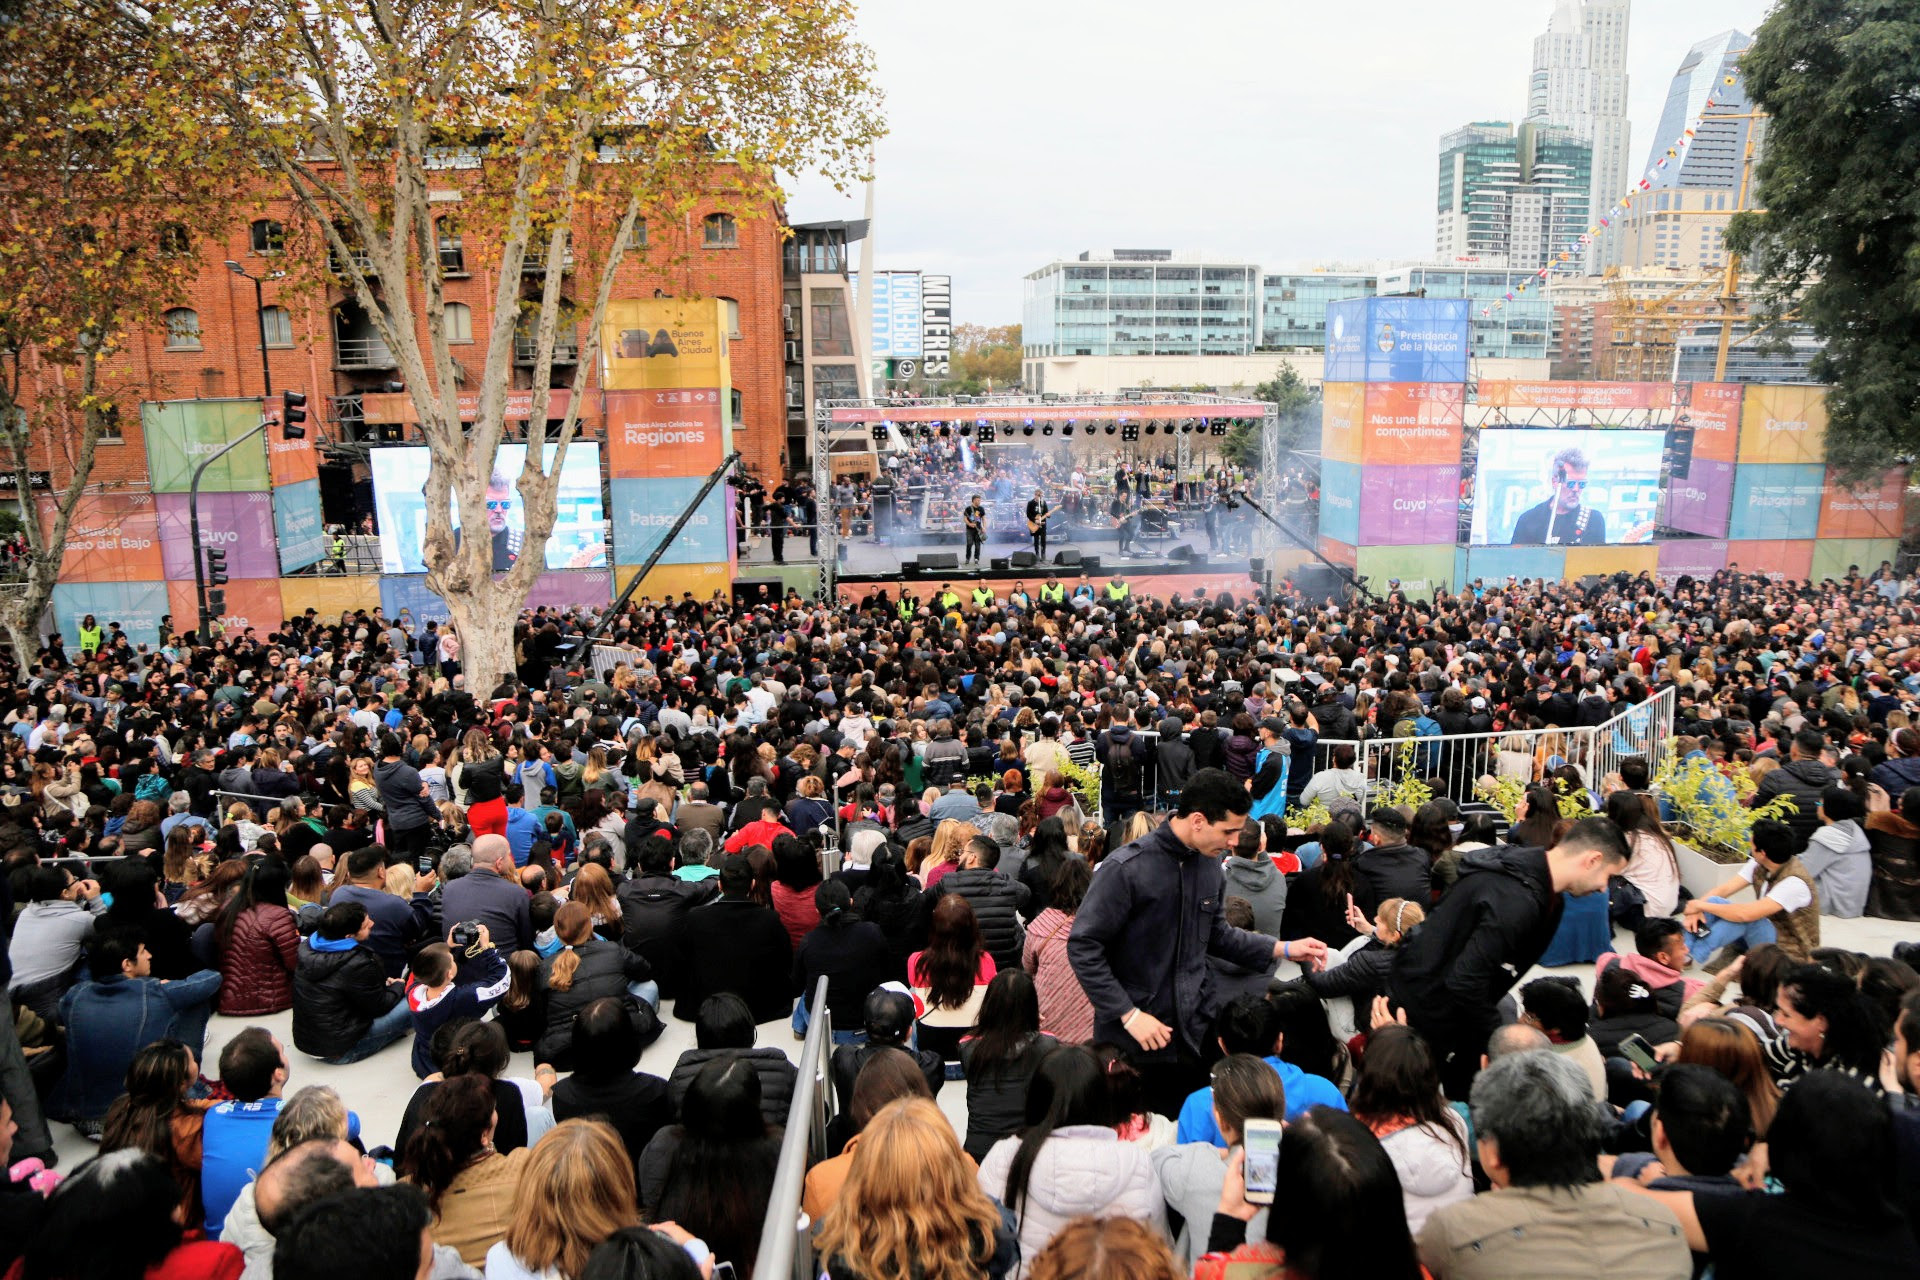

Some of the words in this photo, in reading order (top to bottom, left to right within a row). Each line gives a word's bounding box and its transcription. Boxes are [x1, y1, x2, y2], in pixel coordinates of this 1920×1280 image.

[923, 275, 950, 374] MUJERES
[671, 330, 704, 338] Buenos
[1400, 330, 1458, 340] Presidencia
[678, 338, 702, 346] Aires
[1400, 342, 1413, 351] de
[1414, 342, 1422, 351] la
[1424, 341, 1457, 351] Nación
[680, 346, 713, 354] Ciudad
[1515, 385, 1567, 394] Celebremos
[1568, 385, 1576, 394] la
[1578, 385, 1632, 396] inauguración
[1551, 396, 1575, 404] Paseo
[975, 411, 1018, 419] Celebremos
[1019, 411, 1026, 419] la
[1028, 410, 1073, 419] inauguración
[1075, 410, 1086, 418] del
[1087, 410, 1108, 418] Paseo
[1372, 414, 1393, 425] Nos
[1395, 415, 1416, 425] une
[1418, 414, 1428, 425] lo
[1431, 415, 1452, 427] que
[625, 429, 704, 447] Regiones
[1376, 426, 1450, 438] compartimos.
[1685, 487, 1706, 501] Cuyo
[1393, 498, 1426, 512] Cuyo
[1750, 494, 1806, 508] Patagonia
[1830, 501, 1858, 511] Paseo
[199, 529, 238, 544] Cuyo
[97, 538, 118, 550] del
[121, 537, 151, 551] Bajo
[219, 616, 248, 628] orte
